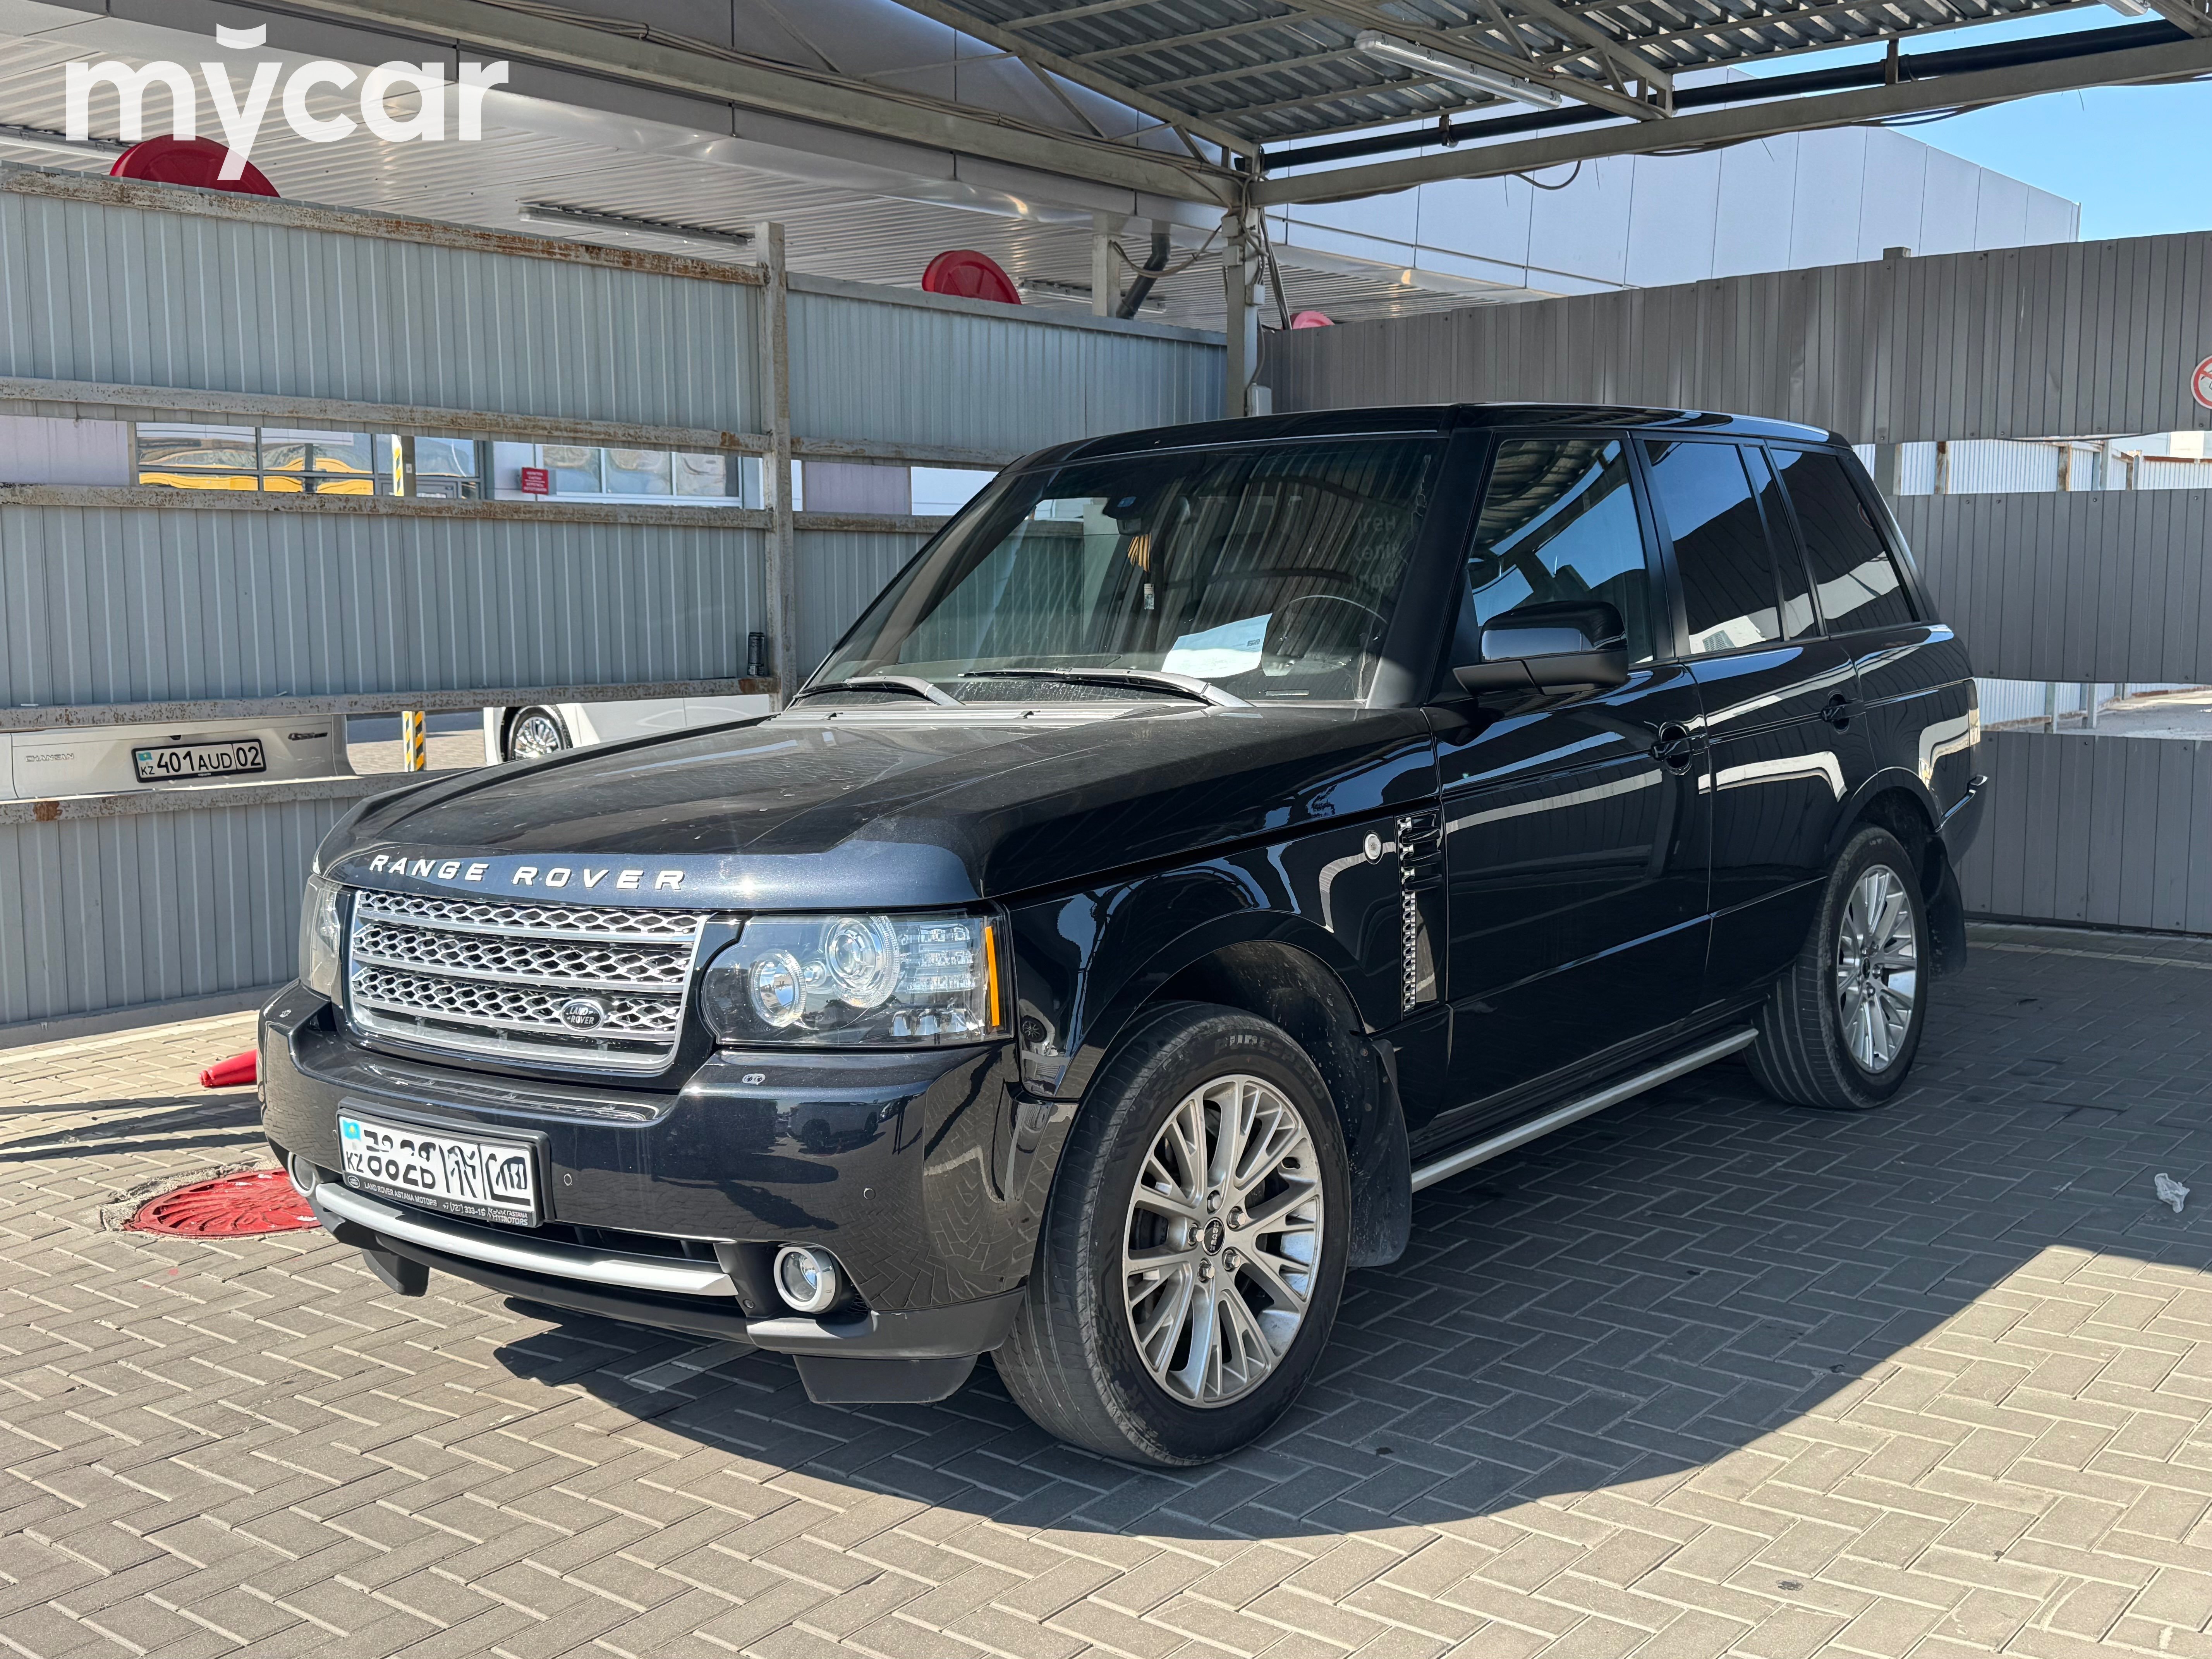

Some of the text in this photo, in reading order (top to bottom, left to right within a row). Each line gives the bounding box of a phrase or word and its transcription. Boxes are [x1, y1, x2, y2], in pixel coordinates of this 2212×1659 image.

[141, 766, 155, 775] KZ
[369, 854, 687, 890] RANGE ROVER
[570, 1007, 594, 1025] LAND ROVER
[364, 1182, 377, 1192] LAND
[378, 1185, 394, 1196] ROVER
[394, 1190, 415, 1202] ASTANA
